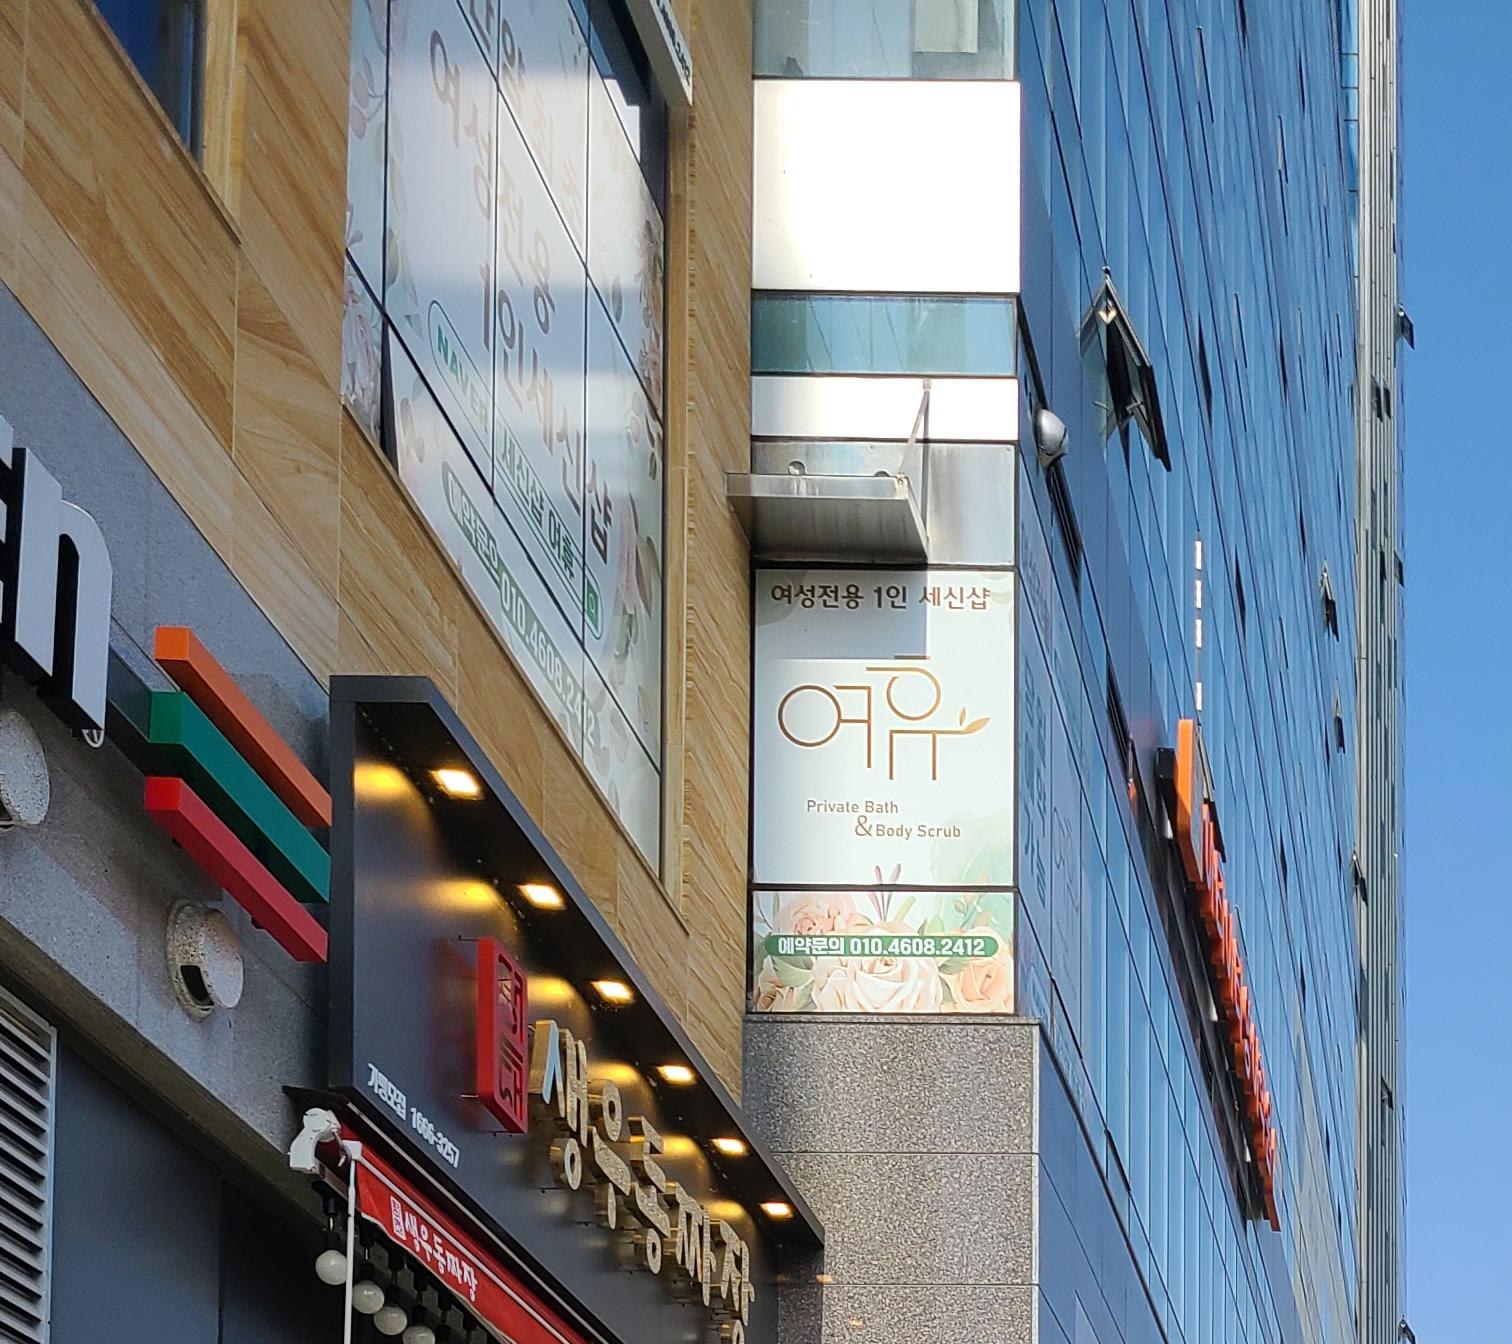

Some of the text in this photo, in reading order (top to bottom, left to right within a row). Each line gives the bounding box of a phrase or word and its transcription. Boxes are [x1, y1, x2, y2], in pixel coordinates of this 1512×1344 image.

[430, 29, 555, 335] 여성전용
[437, 323, 488, 433] NAVER
[770, 584, 992, 612] 여성전용 1인 세신샵
[501, 571, 596, 747] 010.4608.2412
[806, 799, 899, 814] Private Bath
[875, 823, 913, 841] Body
[917, 823, 962, 839] Scrub
[778, 938, 986, 957] 예약문의 010.4608.2412
[404, 1210, 478, 1302] 생우동짜장
